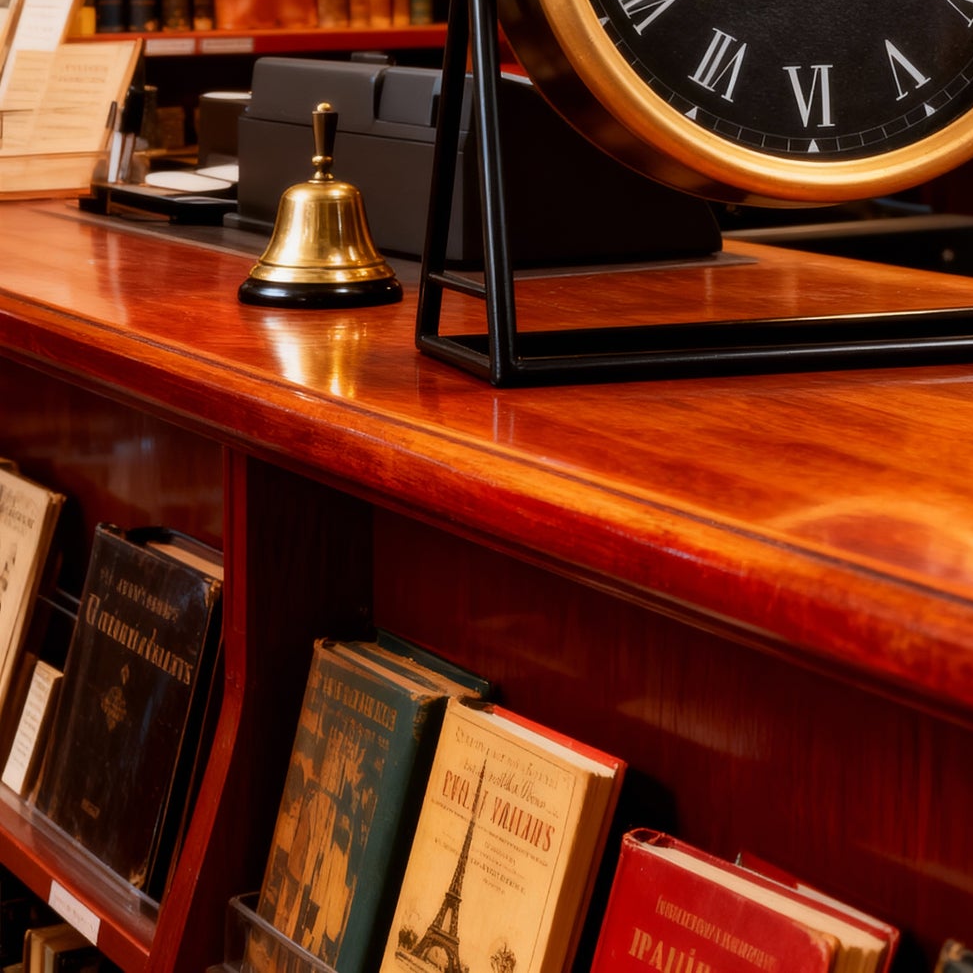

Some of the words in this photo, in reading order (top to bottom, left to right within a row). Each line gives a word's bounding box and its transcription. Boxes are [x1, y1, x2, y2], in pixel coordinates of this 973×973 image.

[688, 28, 747, 102] VII
[782, 65, 835, 128] VI
[884, 39, 931, 101] V
